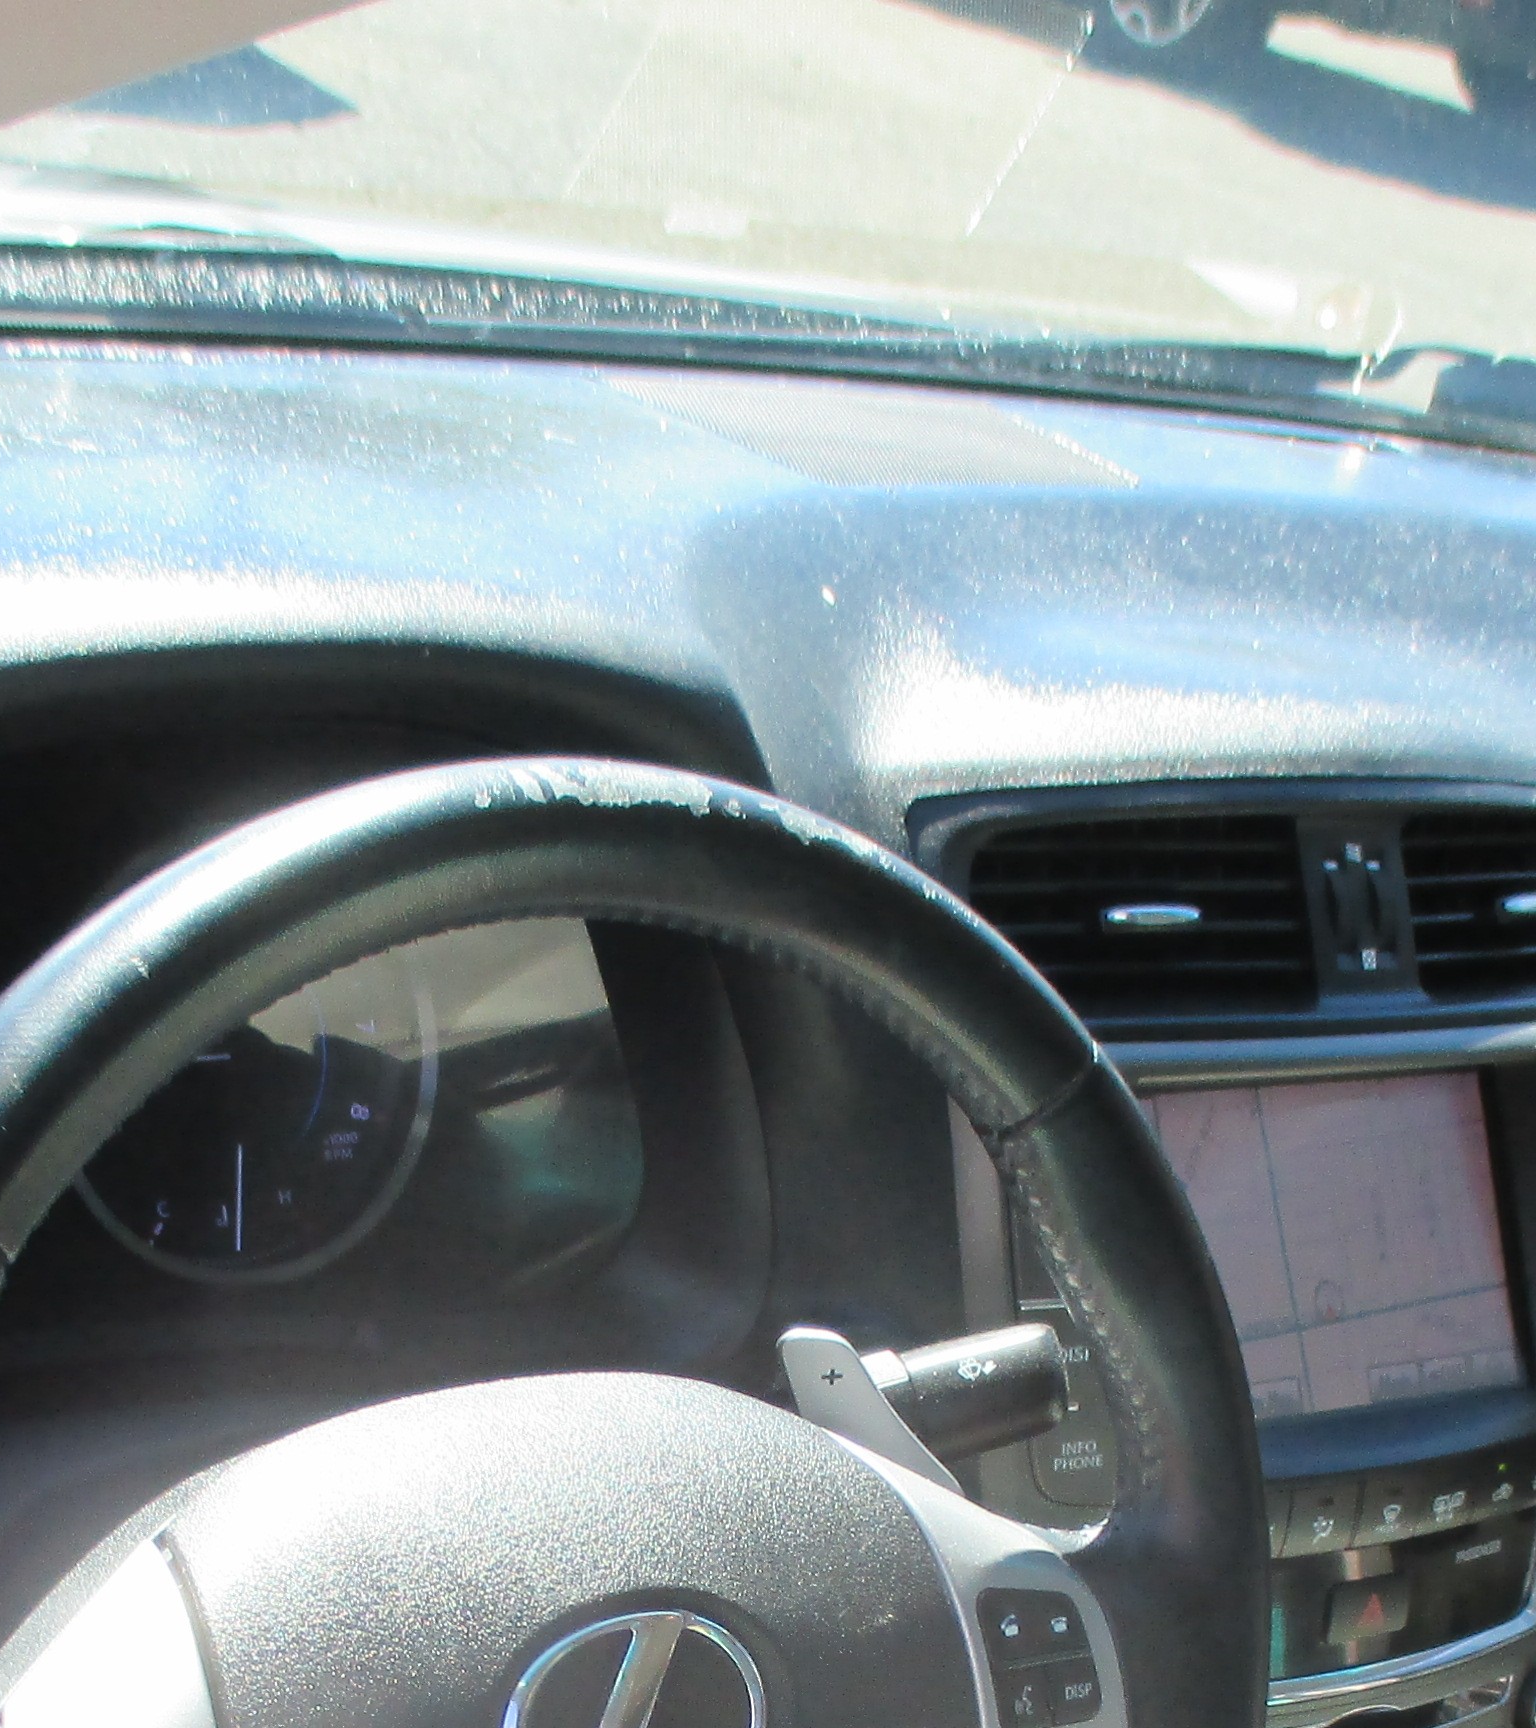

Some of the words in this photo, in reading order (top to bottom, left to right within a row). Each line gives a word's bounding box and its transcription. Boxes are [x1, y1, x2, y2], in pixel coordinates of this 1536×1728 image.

[1061, 1440, 1097, 1457] INFO
[1054, 1454, 1104, 1472] PHONE
[1064, 1682, 1093, 1701] DISP
